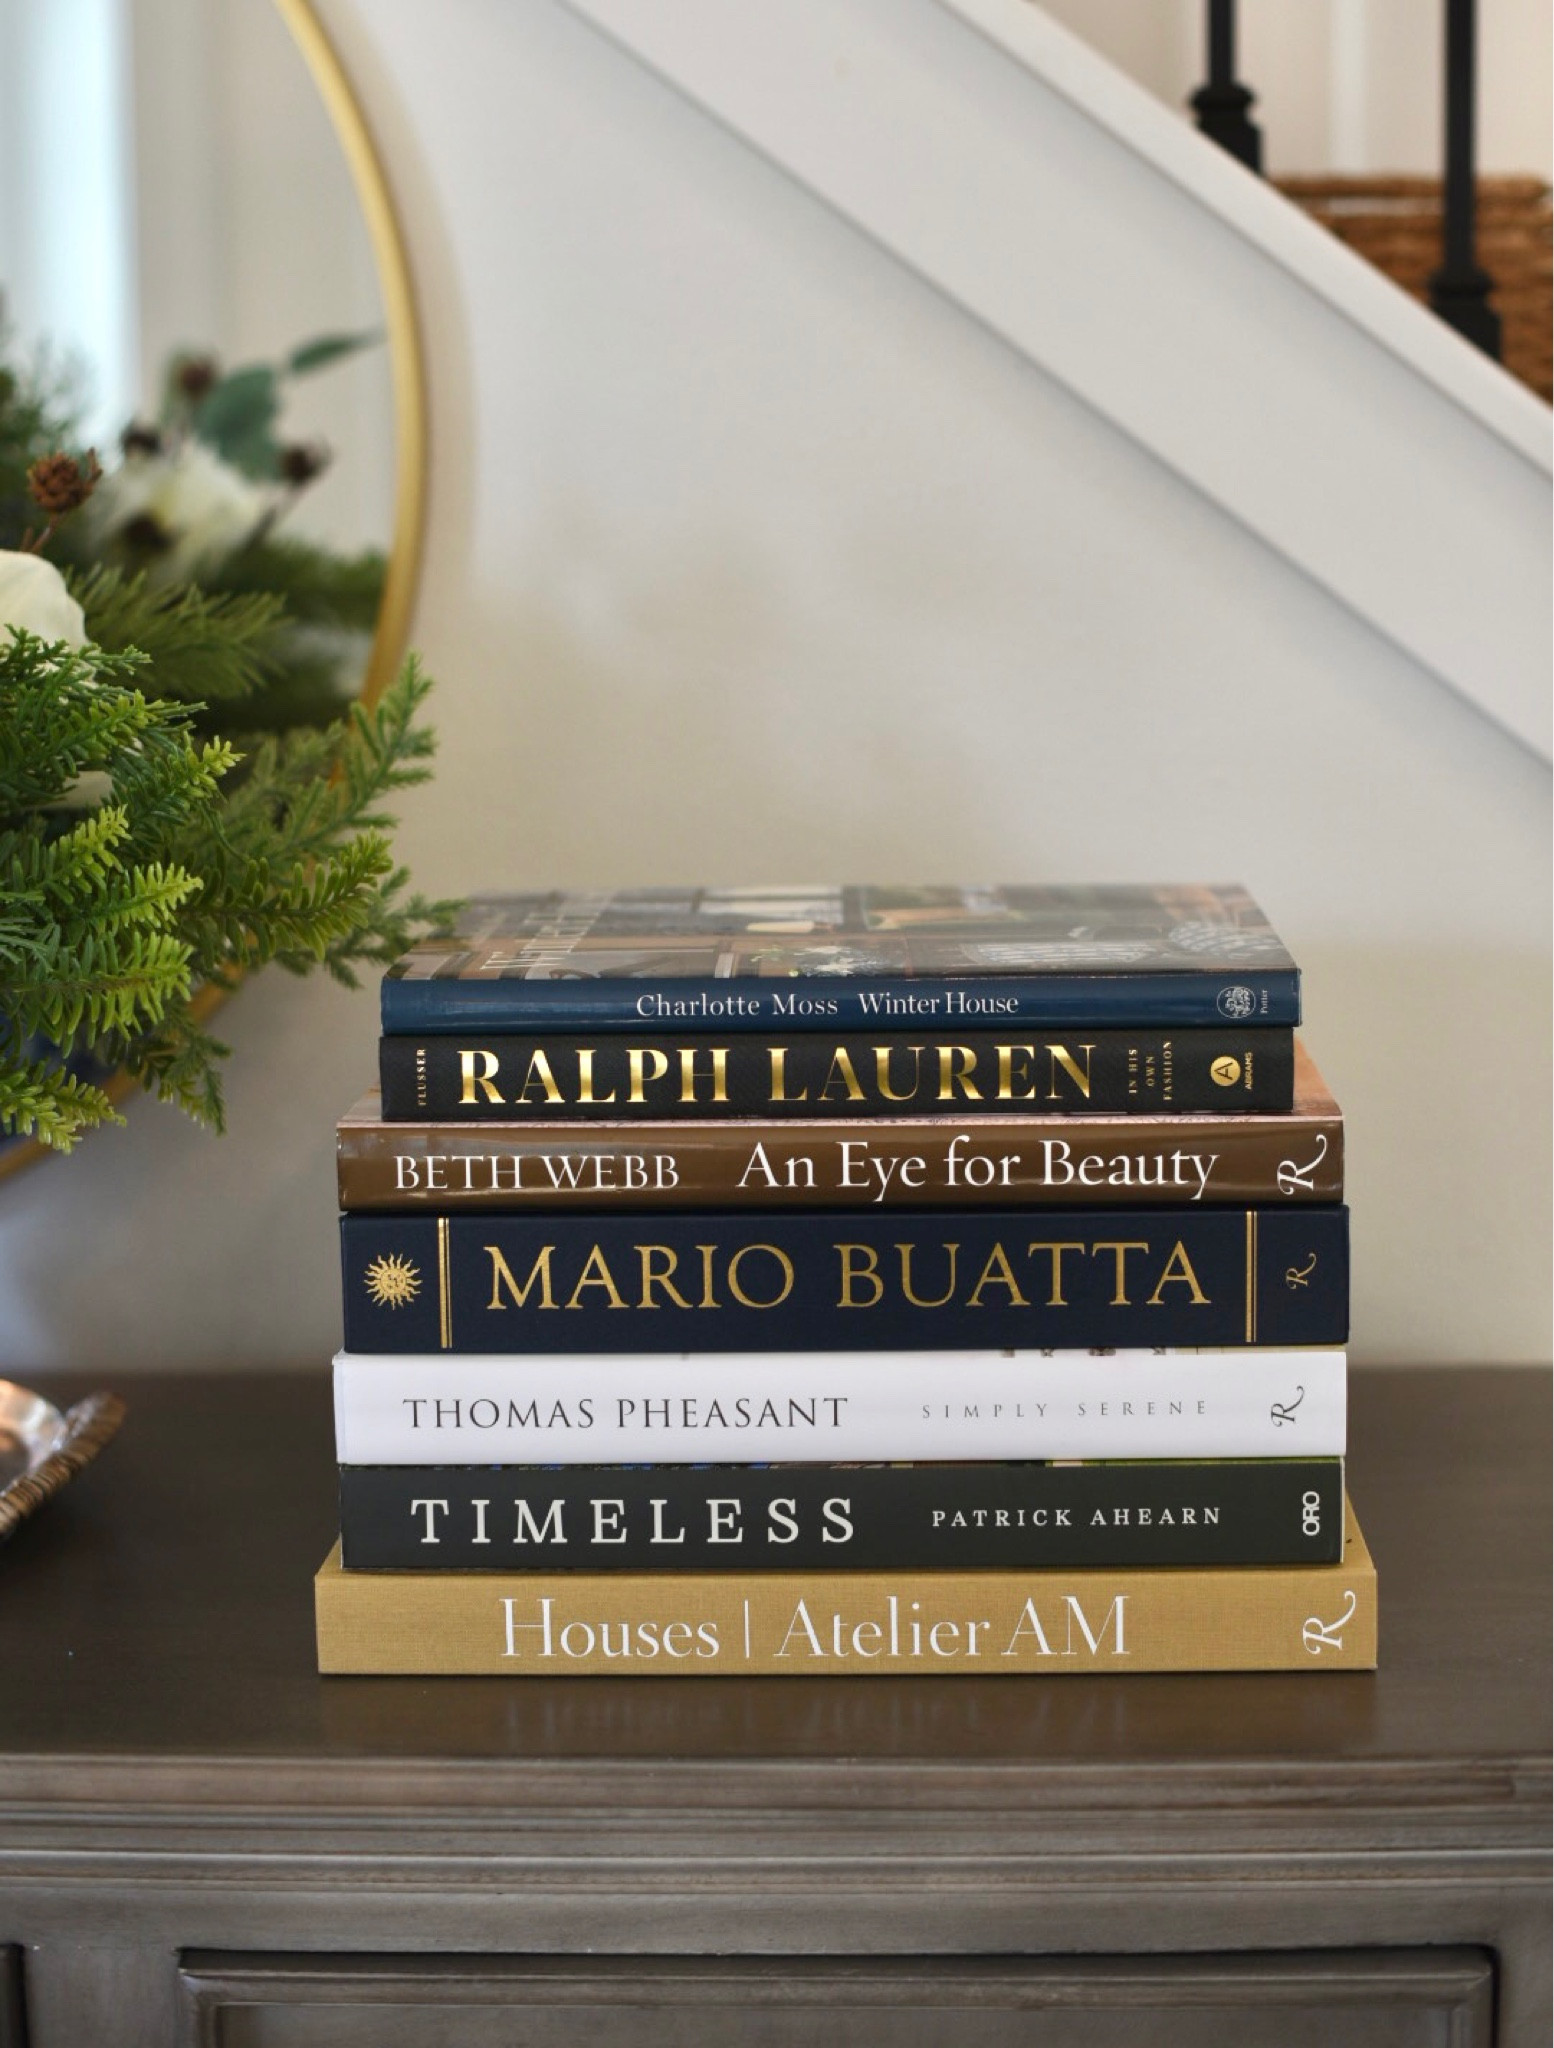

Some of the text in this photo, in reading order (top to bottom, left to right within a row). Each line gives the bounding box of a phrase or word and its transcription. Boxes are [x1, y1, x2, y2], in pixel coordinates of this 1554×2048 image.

[637, 993, 837, 1016] Charlotte Moss
[858, 992, 1018, 1014] Winter House
[457, 1045, 1096, 1103] RALPH LAUREN
[1129, 1050, 1137, 1093] IN HIS
[1146, 1057, 1155, 1086] OWN
[1163, 1041, 1173, 1101] FASHION
[1245, 1052, 1253, 1089] ABRAMS
[395, 1154, 680, 1189] BETH WEBB
[736, 1135, 1219, 1201] An Eye for Beauty
[483, 1241, 1211, 1309] MARIO BUATTA
[403, 1398, 847, 1428] THOMAS PHEASANT
[923, 1401, 1204, 1418] SIMPLY SERENE
[411, 1498, 853, 1543] TIMELESS
[933, 1508, 1219, 1526] PATRICK AHEARN
[499, 1599, 719, 1657] Houses
[774, 1596, 990, 1657] Atelier
[1001, 1596, 1129, 1655] AM
